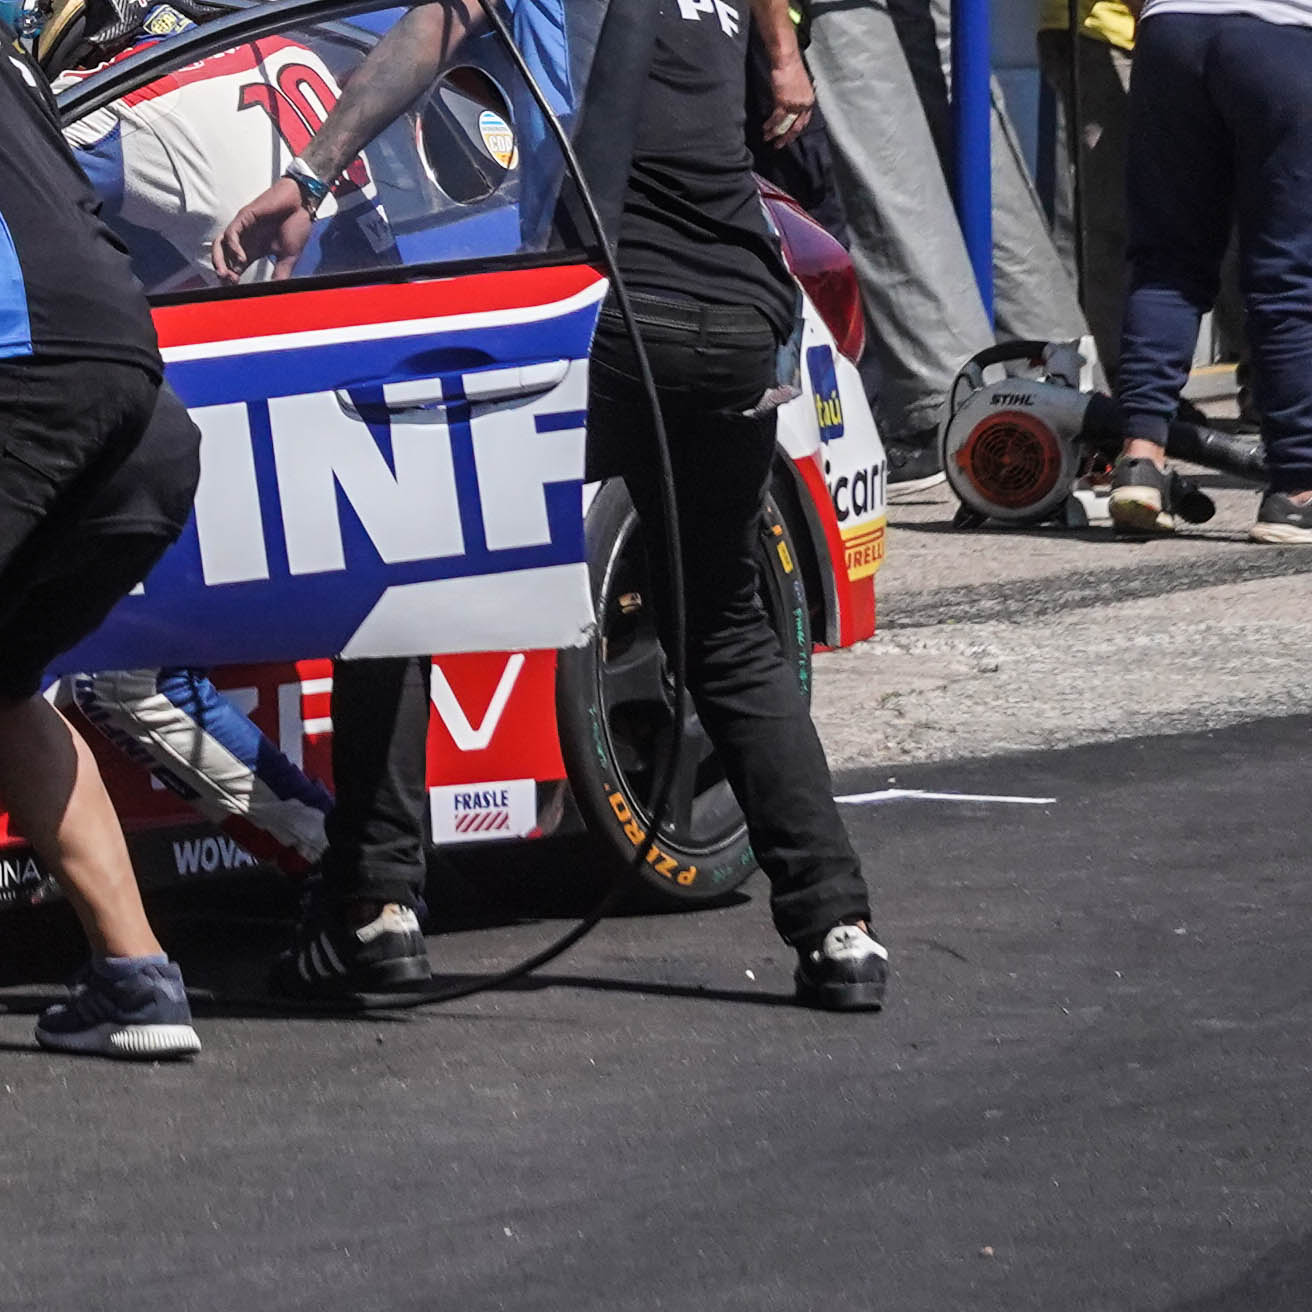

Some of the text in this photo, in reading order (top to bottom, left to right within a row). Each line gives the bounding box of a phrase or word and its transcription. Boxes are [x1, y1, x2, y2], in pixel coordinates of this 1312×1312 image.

[989, 393, 1036, 408] STIHL
[846, 542, 885, 570] IRELL
[174, 835, 260, 876] WOVA
